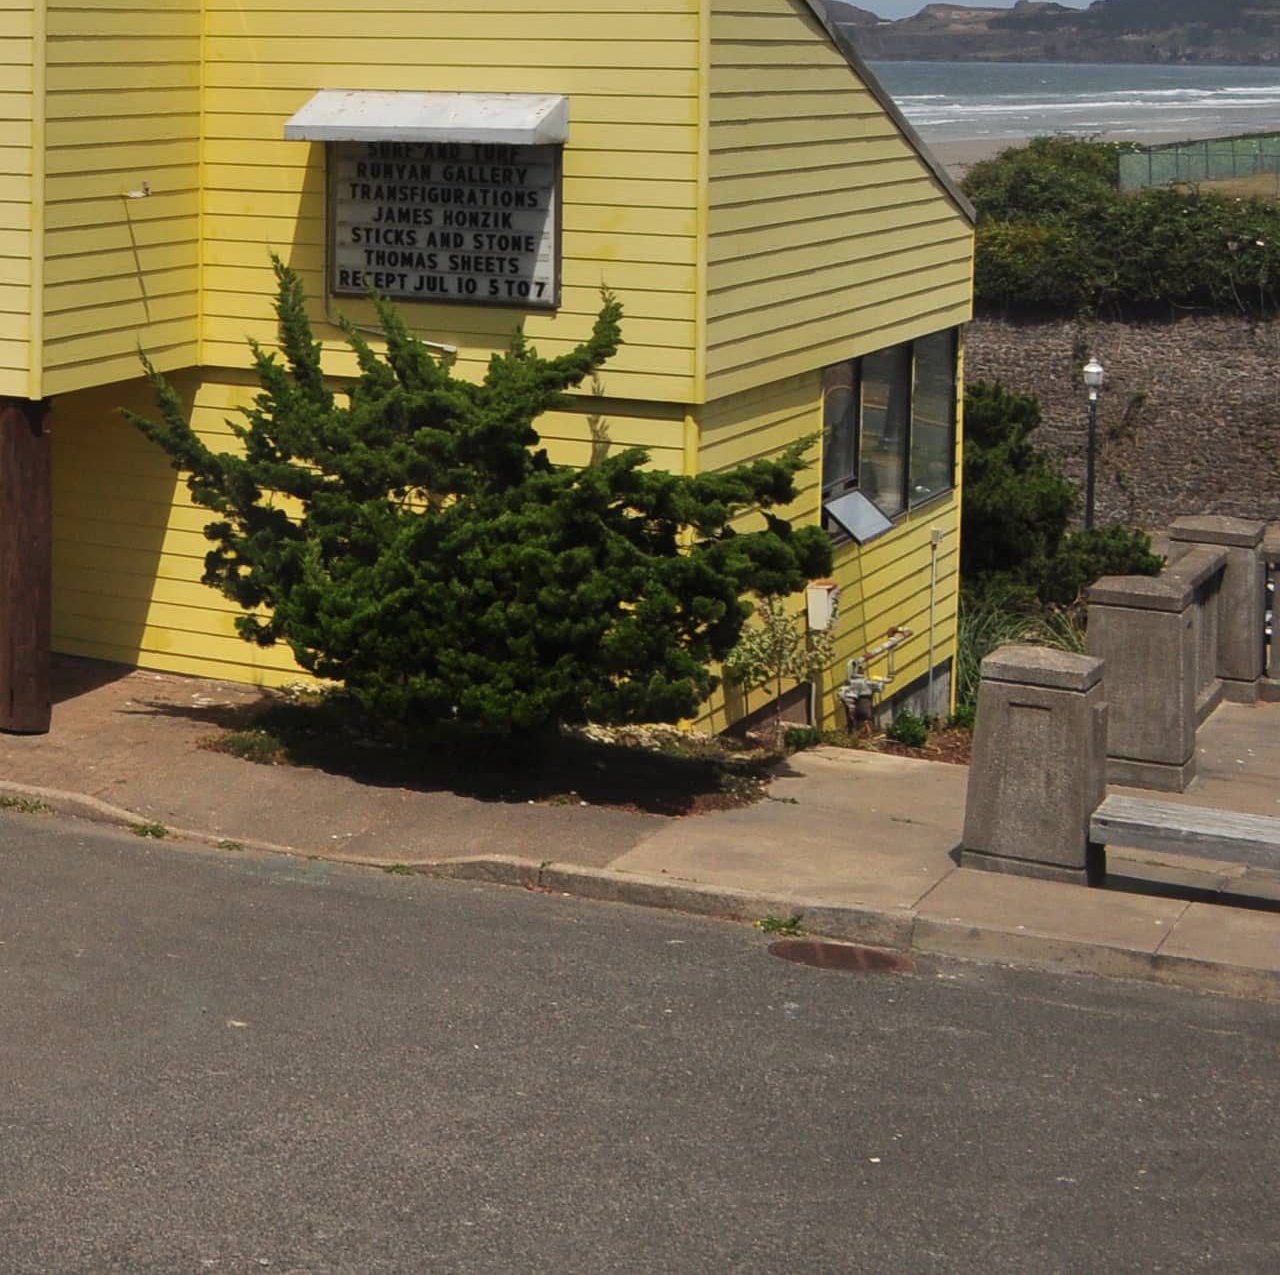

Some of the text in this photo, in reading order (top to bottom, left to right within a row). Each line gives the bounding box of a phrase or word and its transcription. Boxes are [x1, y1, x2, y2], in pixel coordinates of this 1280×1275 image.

[368, 143, 521, 163] SURF AND TURF
[356, 163, 528, 185] RUNYAN GALLERY
[350, 183, 538, 208] TRANSFIGURATIONS
[372, 207, 513, 229] JAMES HONZIK
[351, 227, 535, 253] STICKS AND STONE
[365, 249, 520, 274] THOMAS SHEETS
[414, 275, 448, 293] JUL
[489, 280, 500, 296] 5
[535, 281, 546, 298] 7
